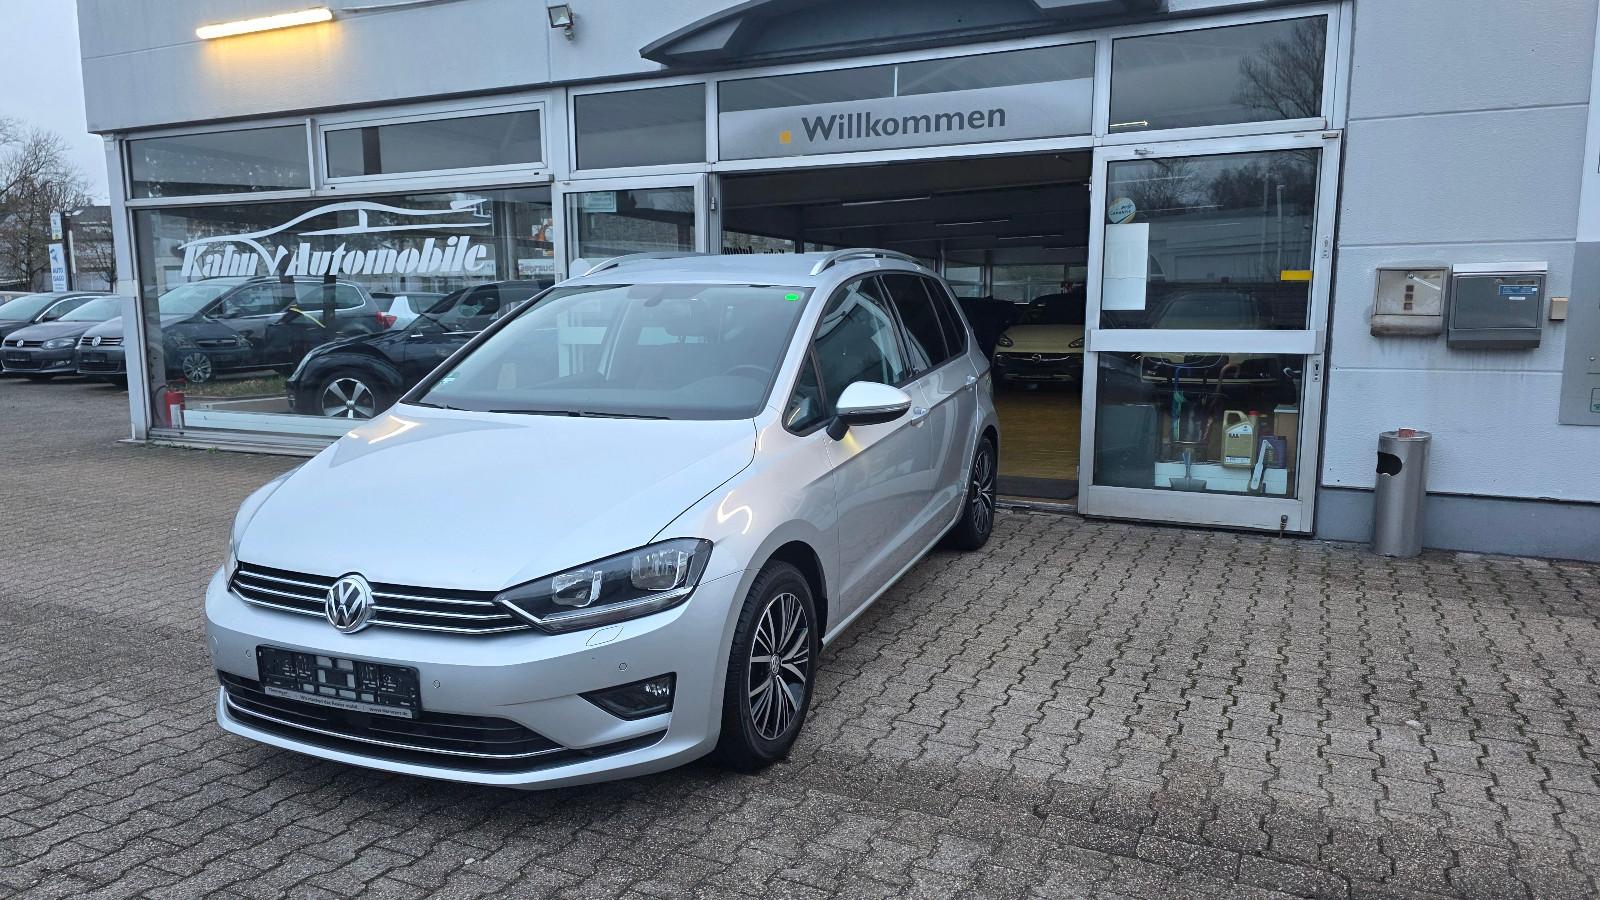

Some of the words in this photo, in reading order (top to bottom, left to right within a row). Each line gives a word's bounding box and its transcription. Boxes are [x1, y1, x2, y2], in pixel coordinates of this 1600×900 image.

[801, 107, 1006, 142] Willkommen
[180, 245, 260, 276] Kahn
[284, 235, 488, 276] Automobile
